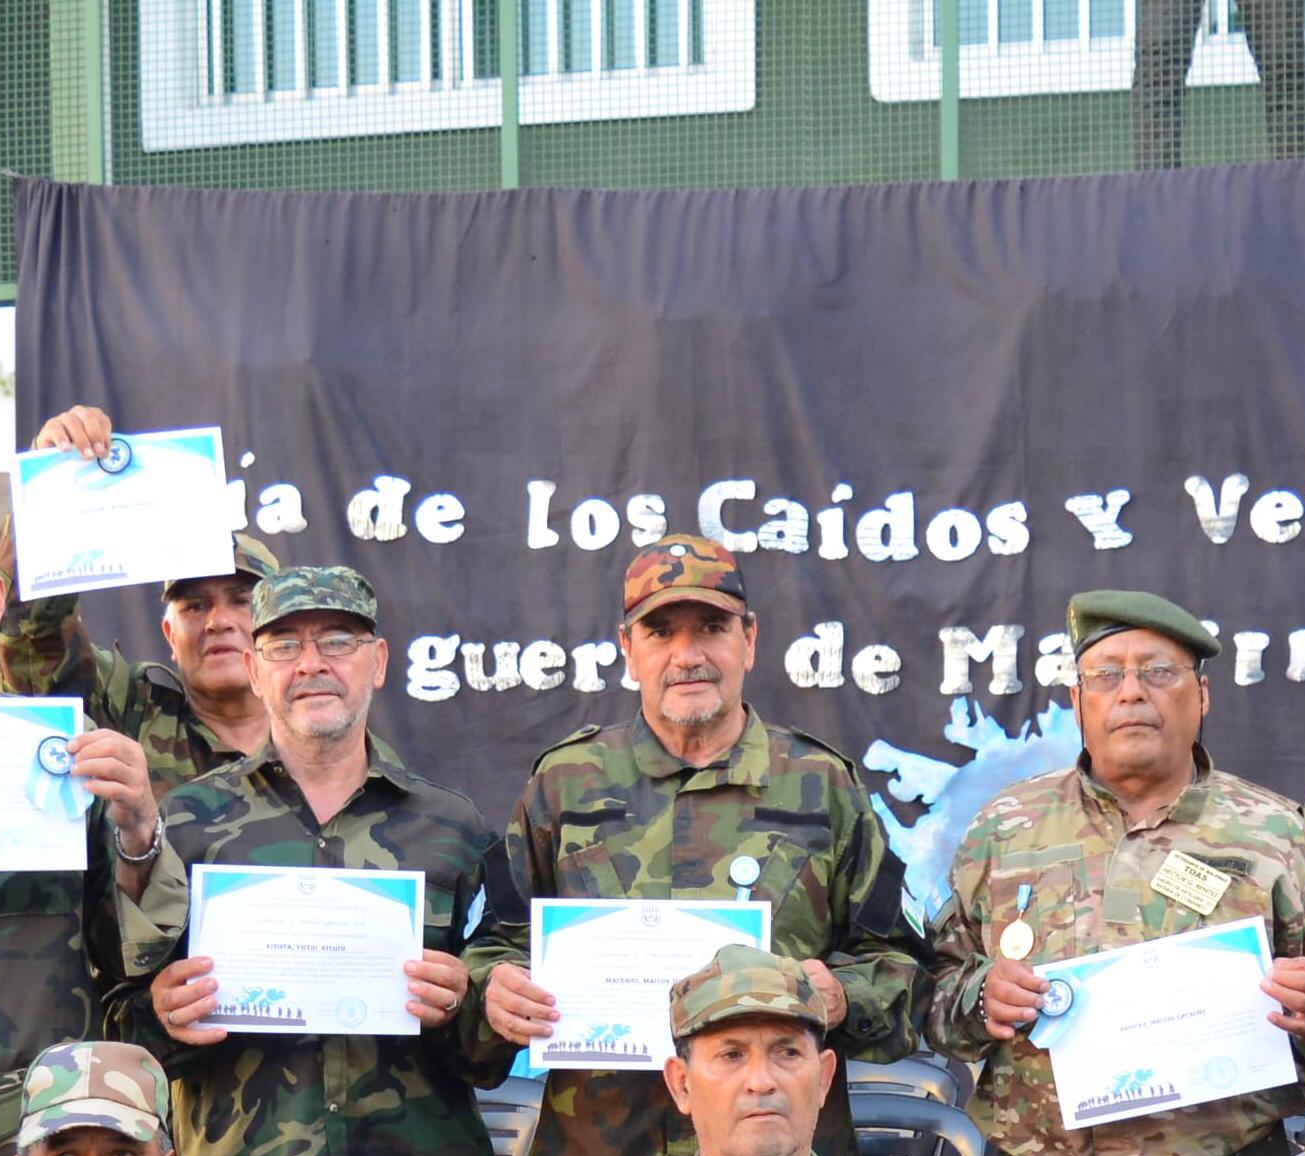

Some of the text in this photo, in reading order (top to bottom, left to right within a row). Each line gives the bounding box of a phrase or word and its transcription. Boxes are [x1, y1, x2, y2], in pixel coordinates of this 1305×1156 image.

[226, 450, 308, 536] ía
[346, 475, 465, 544] de
[526, 479, 668, 551] los
[783, 621, 902, 695] de
